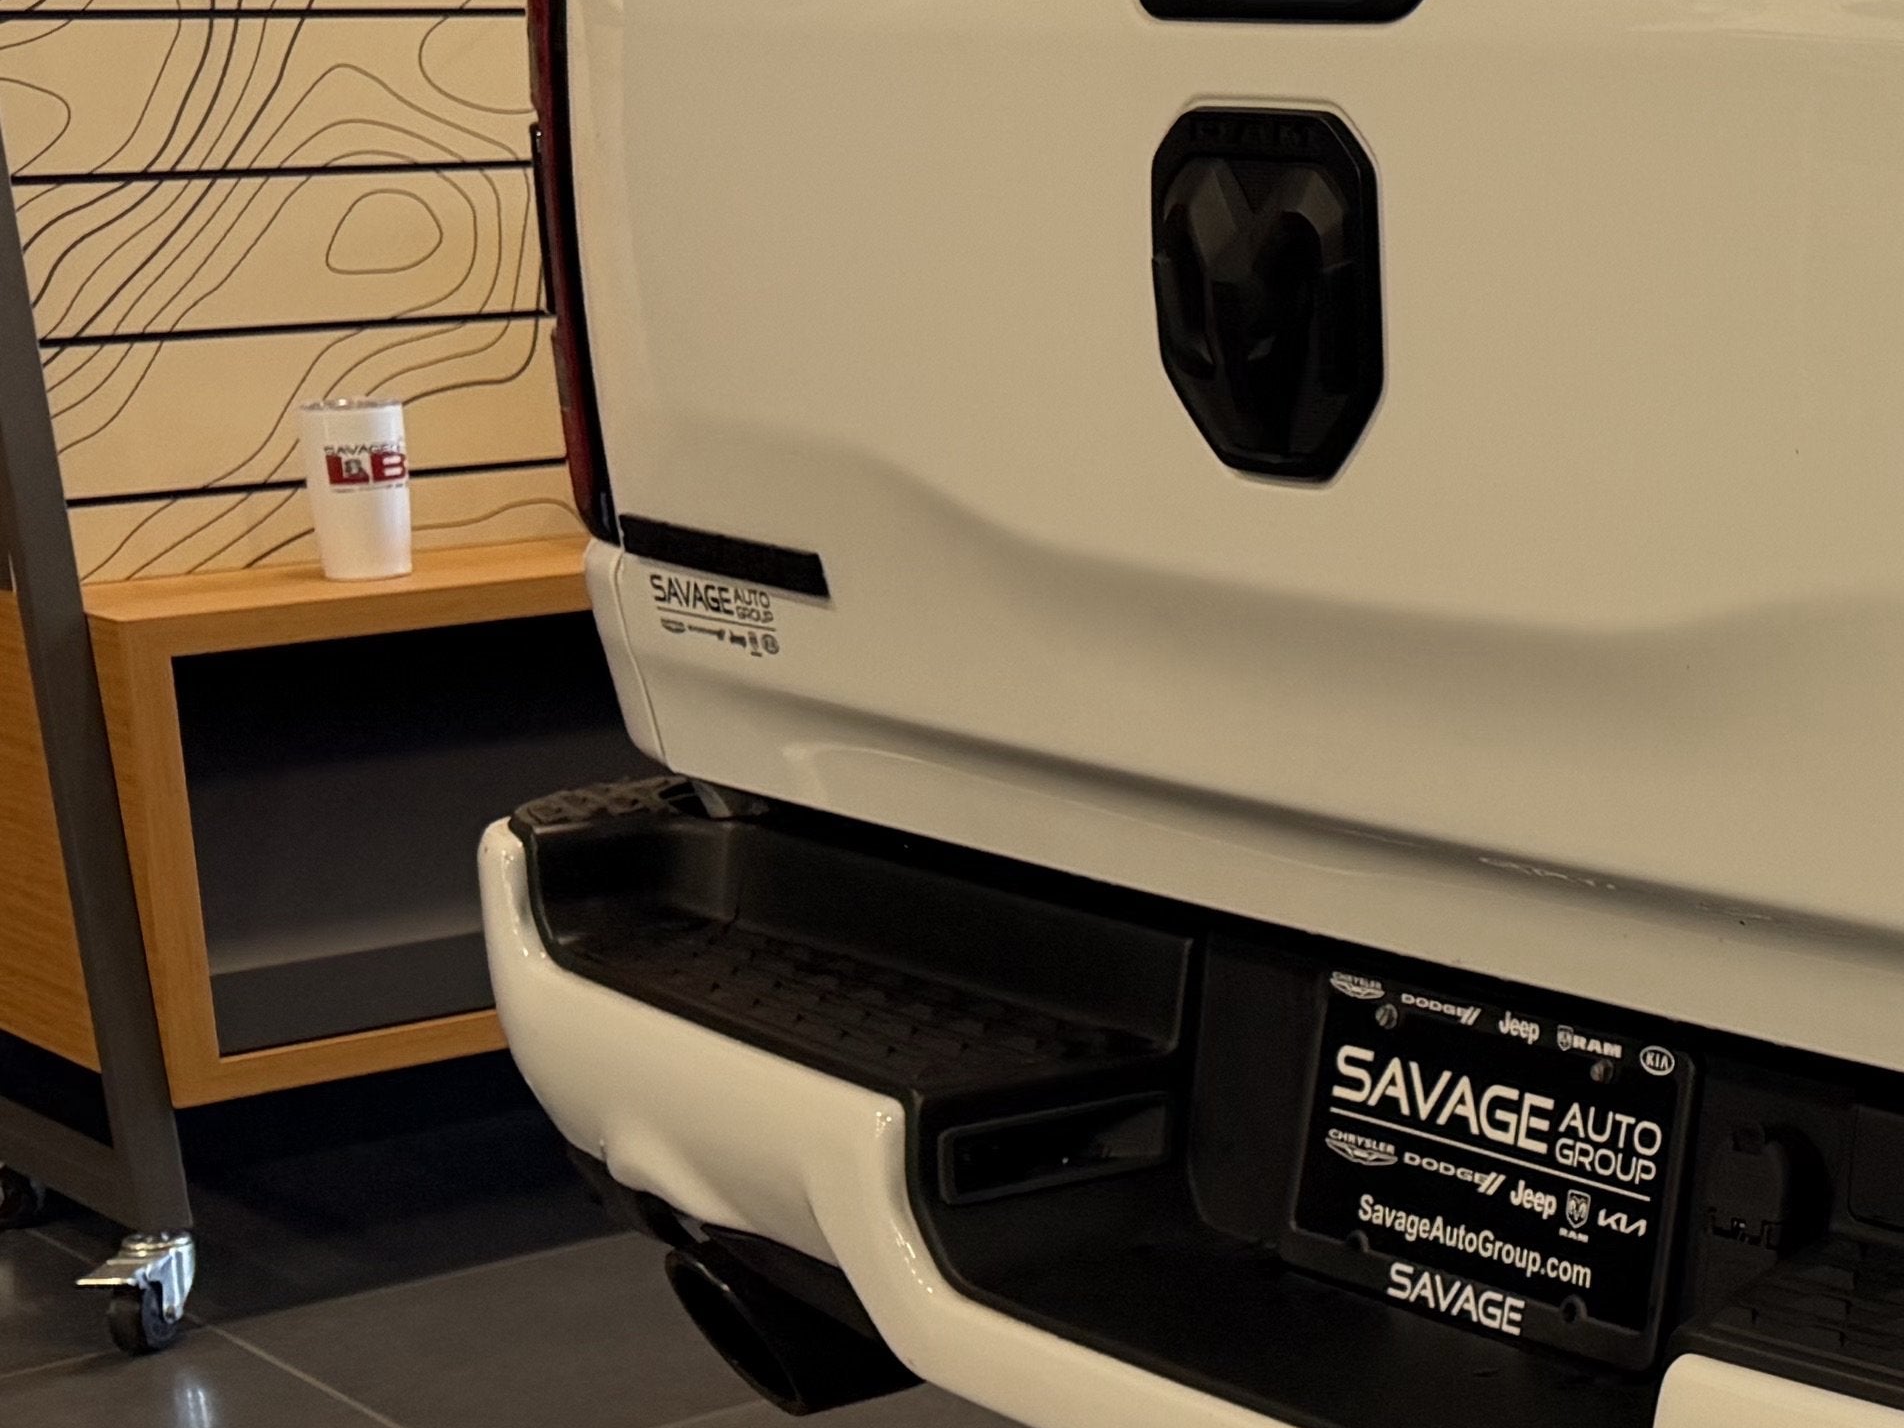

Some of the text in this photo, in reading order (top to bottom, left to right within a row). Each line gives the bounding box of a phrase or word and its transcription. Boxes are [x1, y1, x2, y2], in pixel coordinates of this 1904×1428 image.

[650, 574, 770, 616] SAVAGE AUTO
[1499, 1010, 1540, 1045] Jeep
[1572, 1033, 1622, 1058] RAM
[1332, 1045, 1662, 1156] SAVAGE AUTO
[1328, 1128, 1395, 1155] CHRYSLER
[1403, 1152, 1489, 1186] DODGE
[1510, 1179, 1557, 1220] Jeep
[1559, 1227, 1589, 1243] RAM
[1555, 1138, 1656, 1185] GROUP
[1358, 1194, 1592, 1289] SavageAutoGroup.com
[1387, 1262, 1526, 1336] SAVAGE
